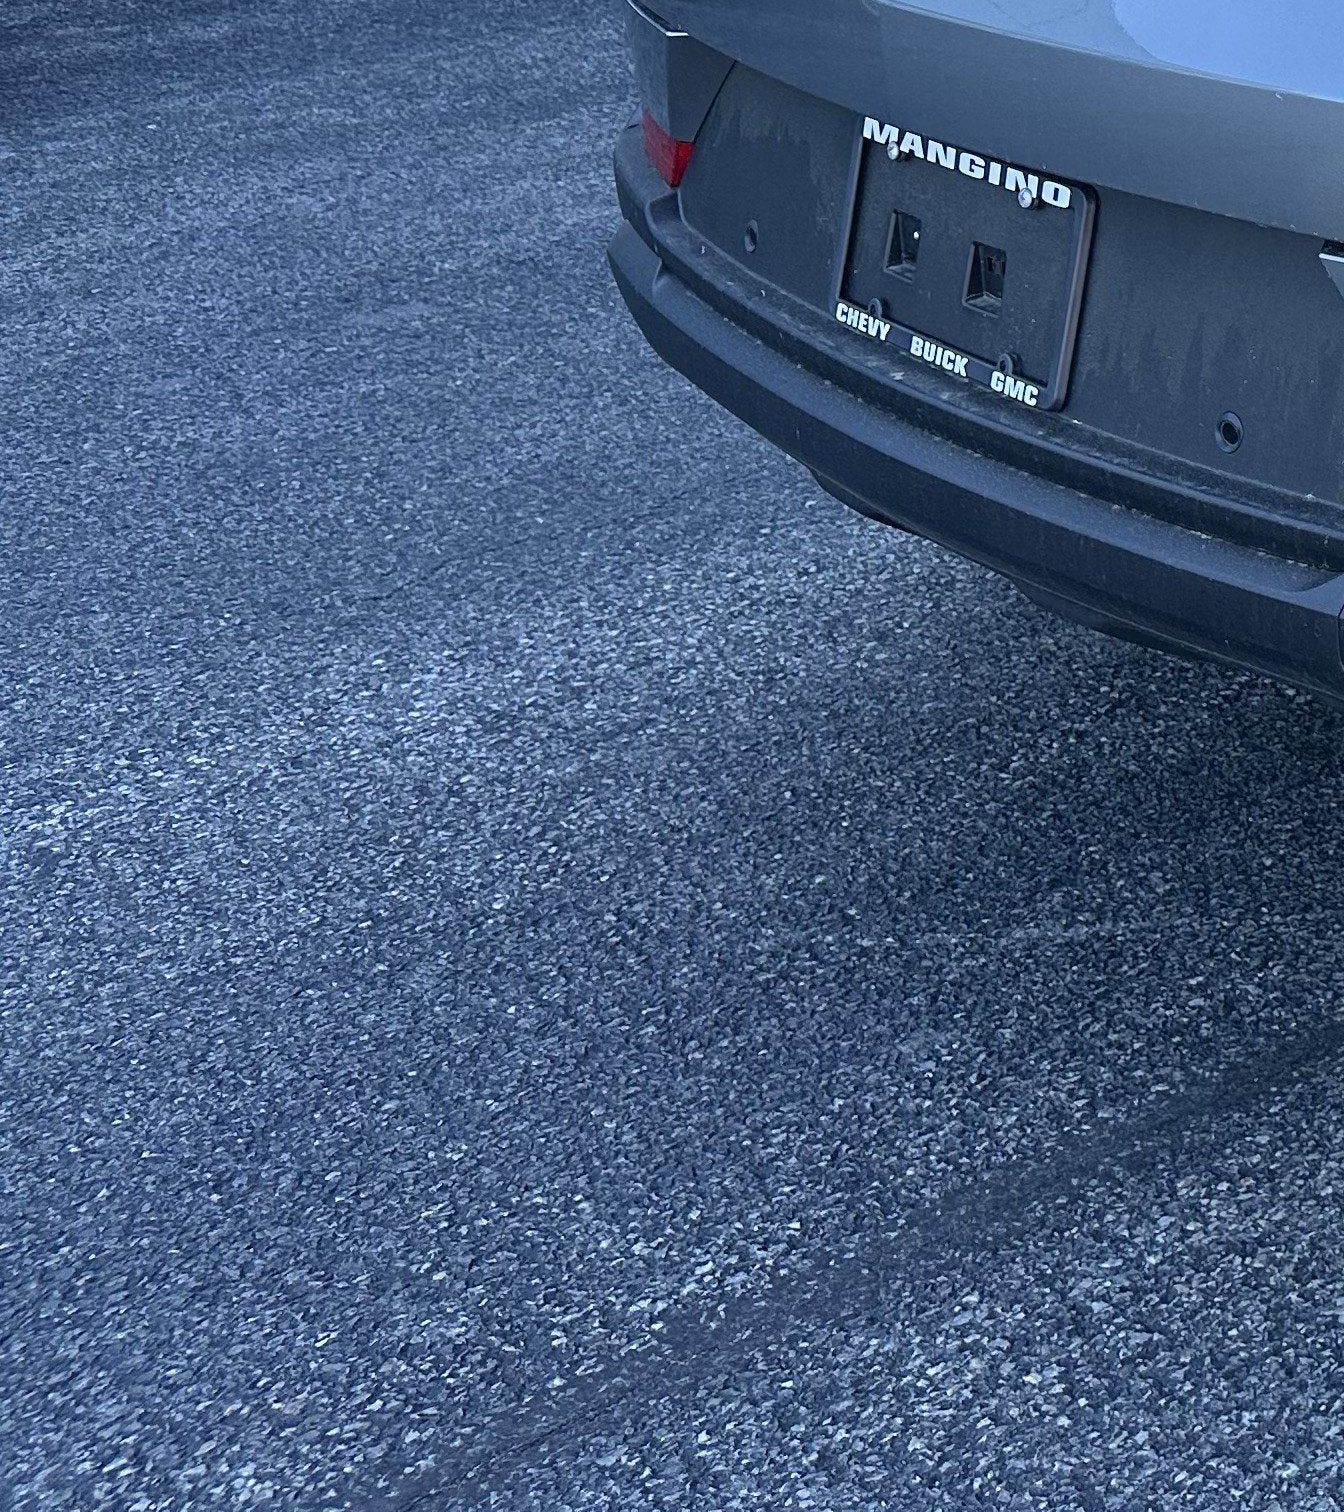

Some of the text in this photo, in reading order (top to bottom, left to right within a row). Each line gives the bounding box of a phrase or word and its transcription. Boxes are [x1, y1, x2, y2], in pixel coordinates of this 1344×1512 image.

[862, 116, 1072, 209] MANGINO
[836, 302, 1039, 407] CHEVY BUICK GMC
